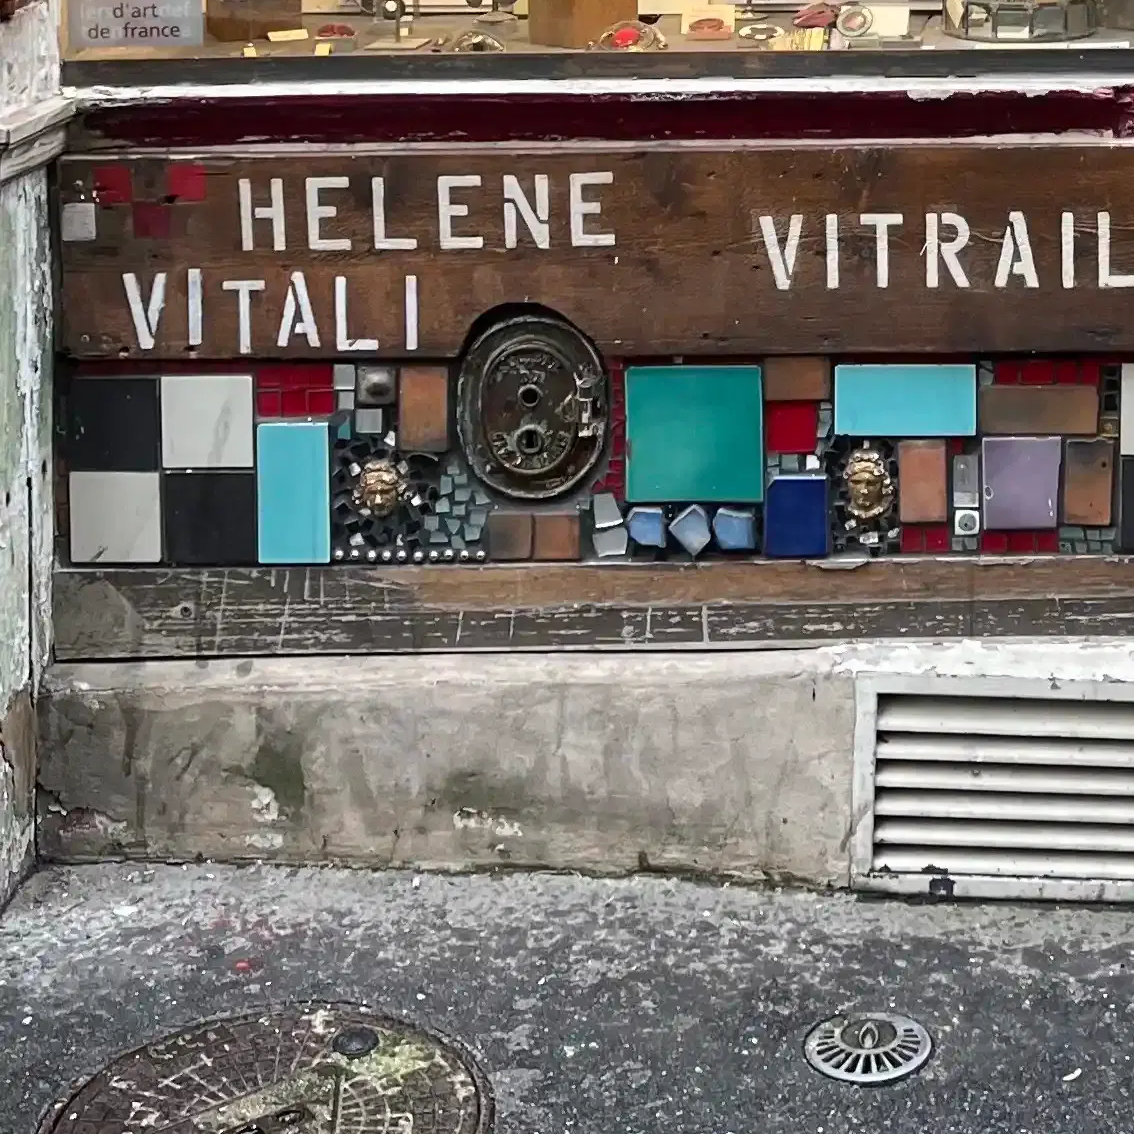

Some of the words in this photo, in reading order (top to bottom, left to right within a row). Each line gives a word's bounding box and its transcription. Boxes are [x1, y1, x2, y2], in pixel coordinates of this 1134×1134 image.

[88, 24, 110, 39] de
[122, 22, 181, 38] france
[112, 2, 160, 19] d'art
[237, 171, 617, 253] HELENE
[121, 268, 420, 354] VITALI
